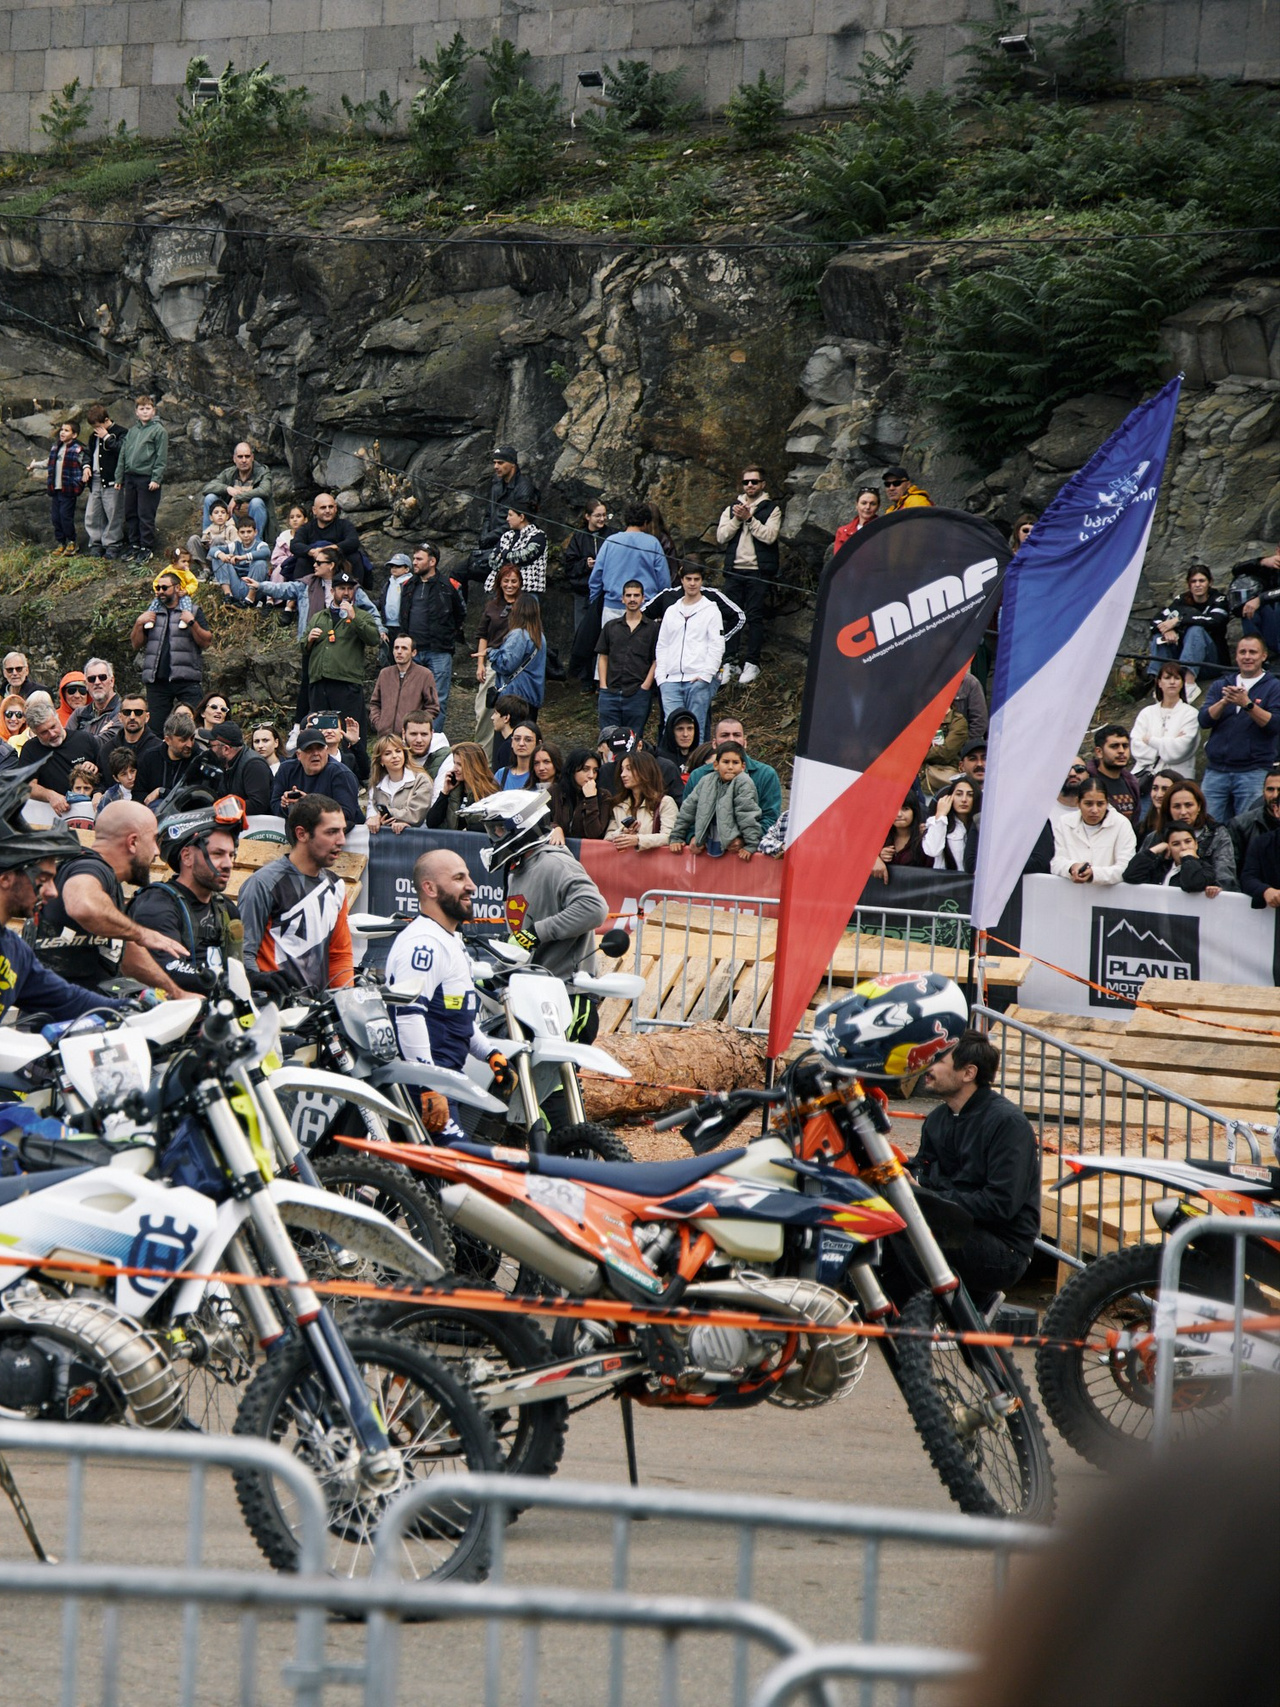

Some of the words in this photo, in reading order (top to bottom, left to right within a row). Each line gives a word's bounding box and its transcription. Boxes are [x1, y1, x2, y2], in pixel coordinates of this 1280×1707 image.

[1109, 960, 1168, 980] PLAN
[1174, 966, 1189, 980] B
[377, 1026, 395, 1047] 29
[111, 1070, 129, 1094] 2
[539, 1178, 574, 1205] 26
